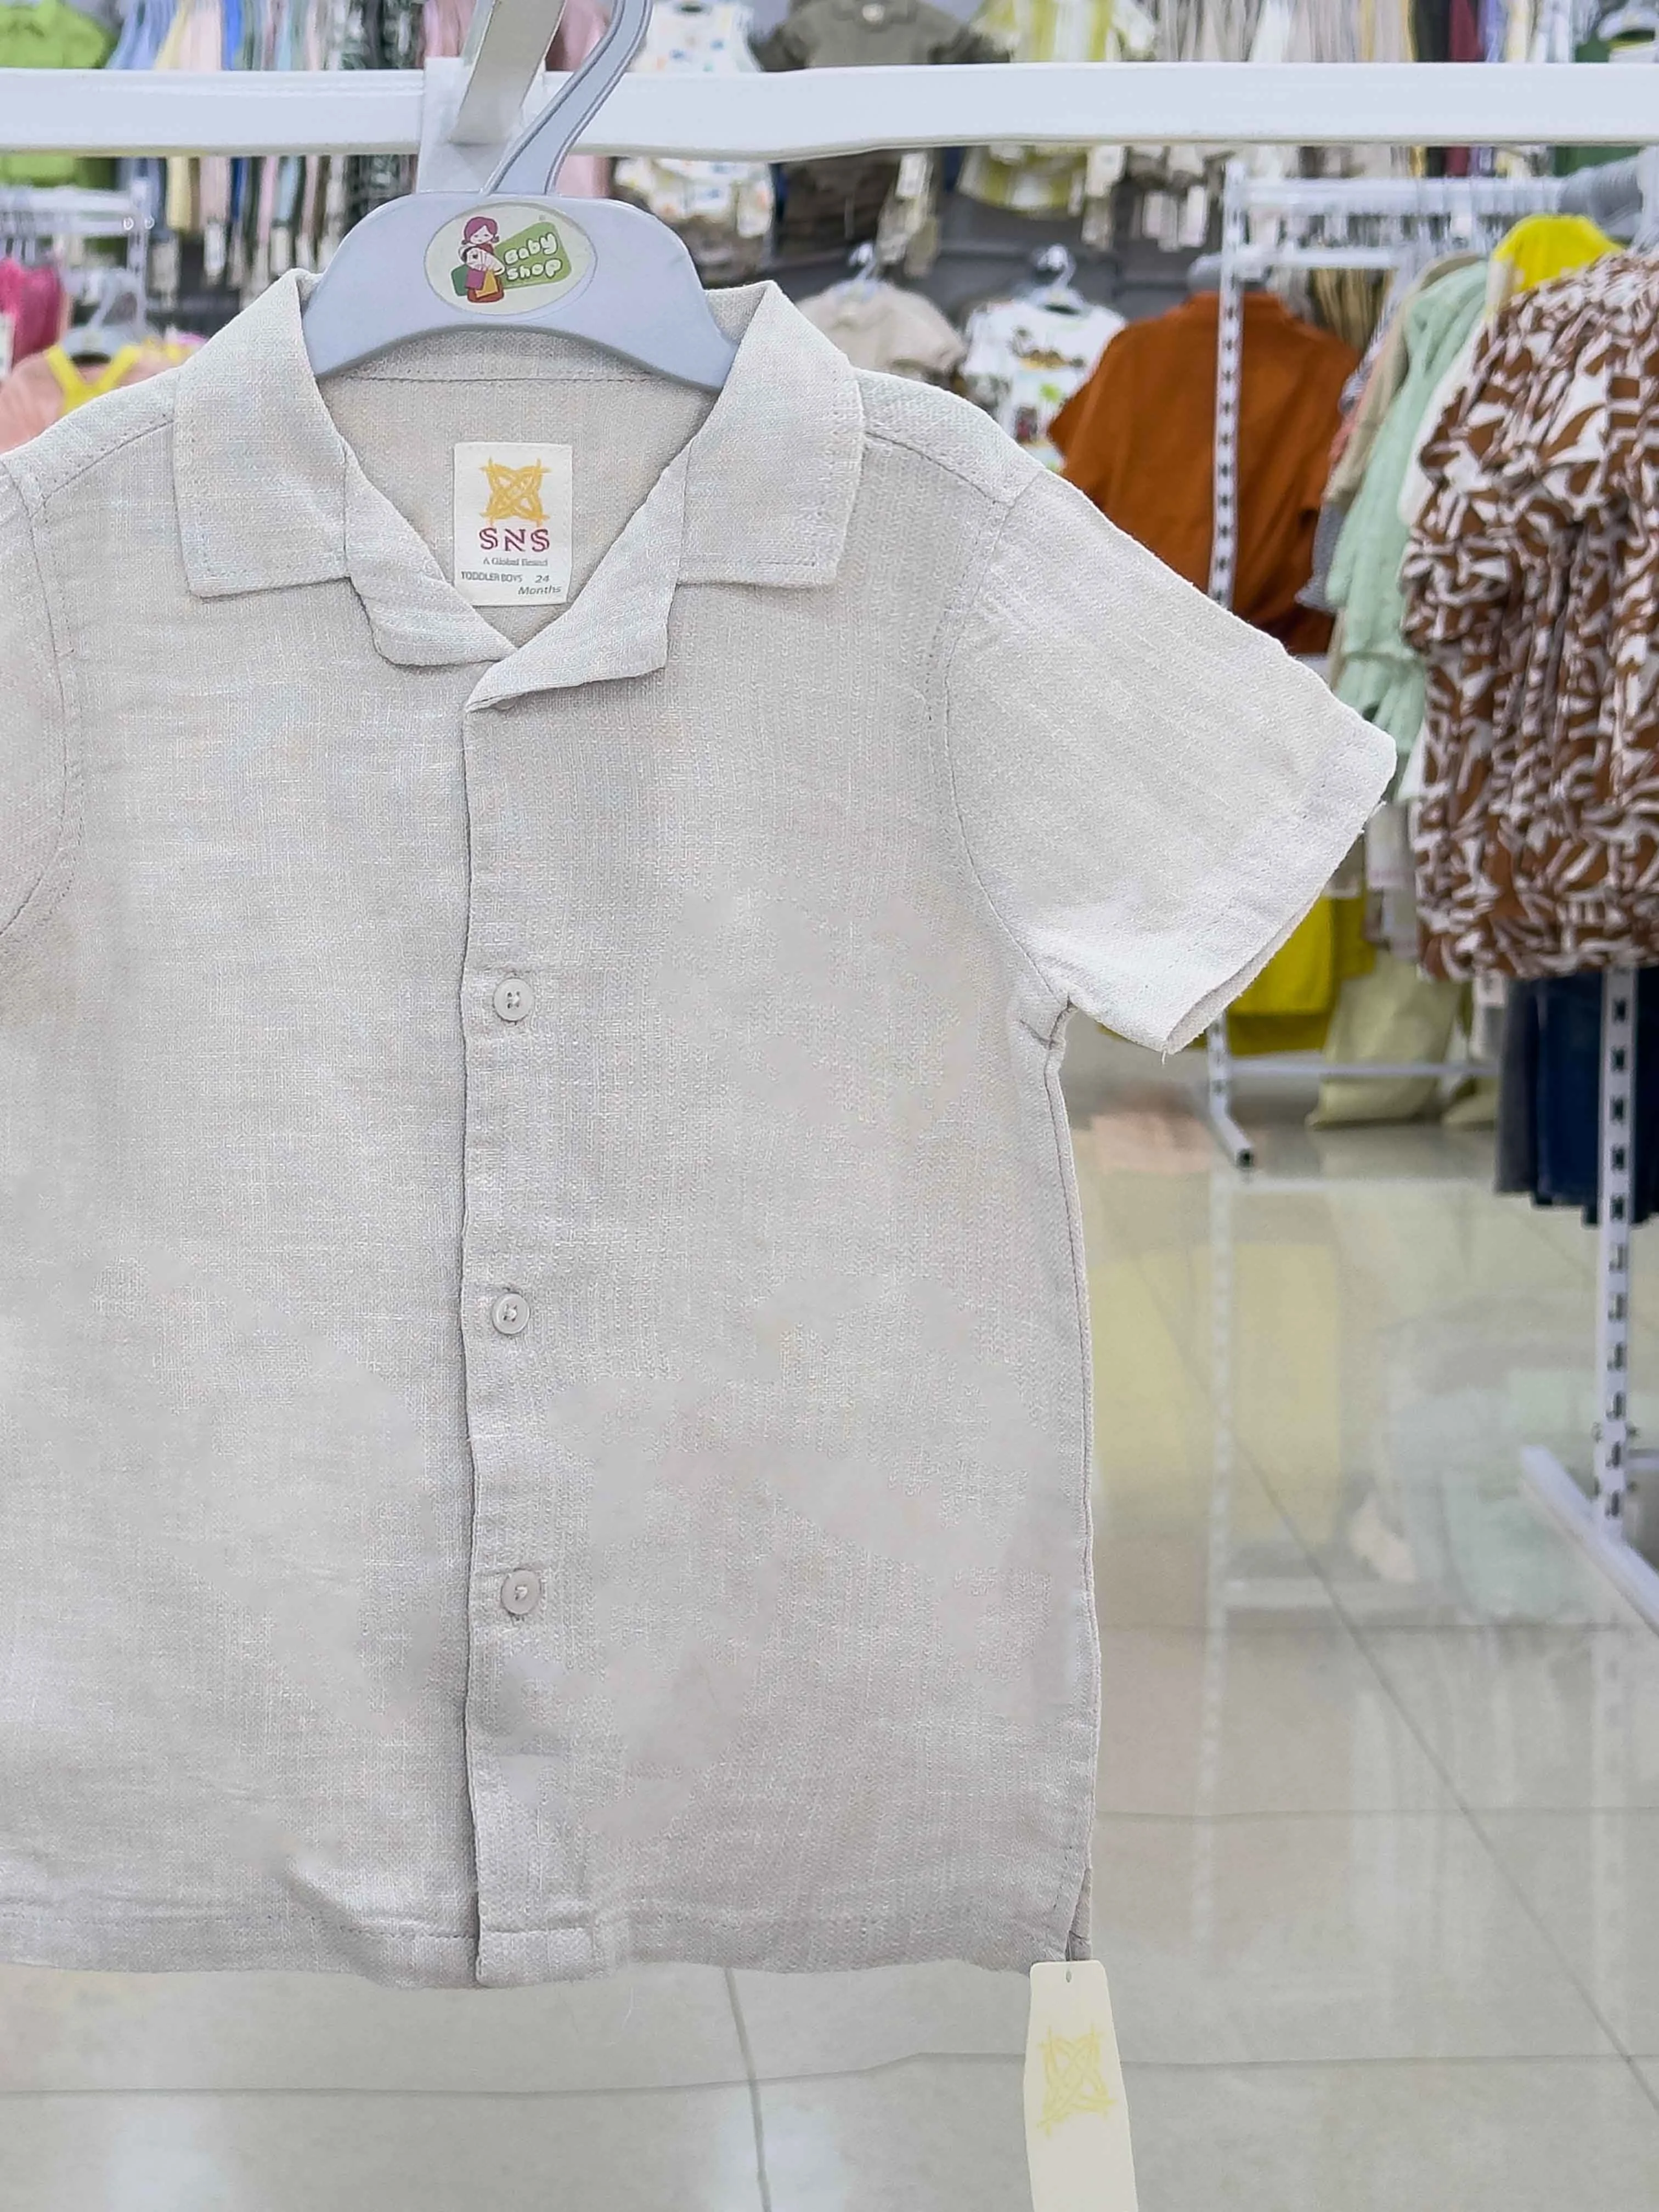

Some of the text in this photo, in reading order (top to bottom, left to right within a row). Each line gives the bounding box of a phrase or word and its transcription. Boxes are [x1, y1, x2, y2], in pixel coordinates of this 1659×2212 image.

[504, 232, 558, 266] Baby
[479, 527, 550, 552] SNS
[461, 571, 549, 583] TODDLER BOYS 24
[518, 585, 562, 595] Months
